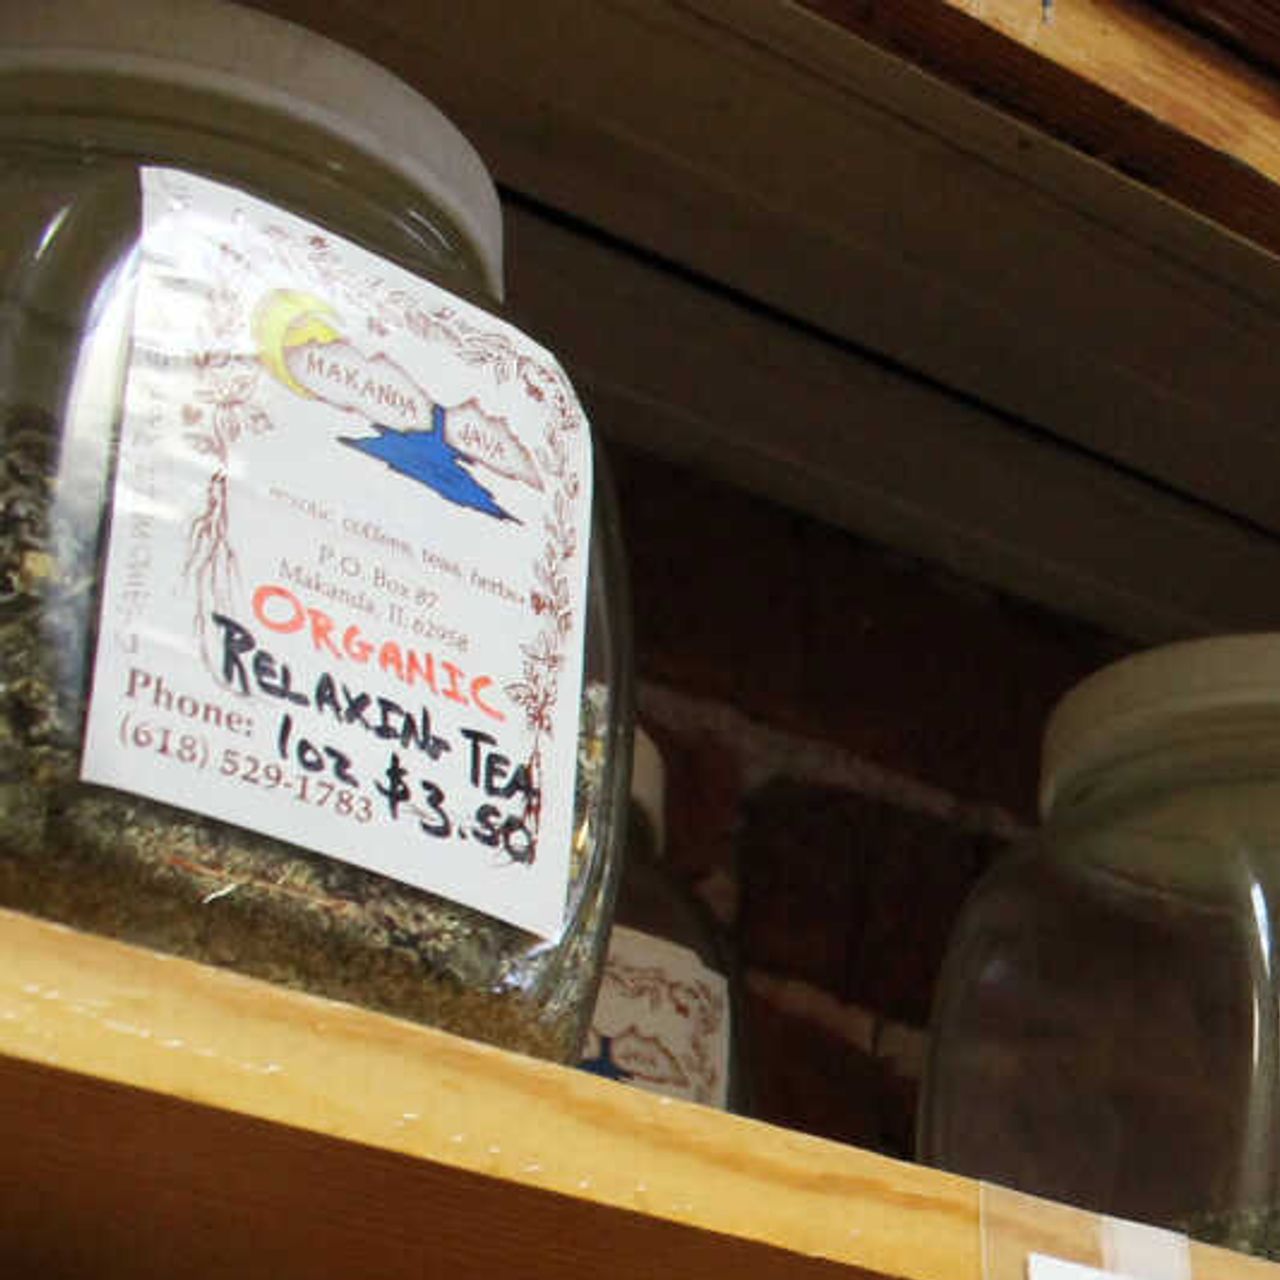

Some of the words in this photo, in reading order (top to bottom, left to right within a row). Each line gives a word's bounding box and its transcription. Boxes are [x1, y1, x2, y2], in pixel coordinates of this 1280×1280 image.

[306, 352, 418, 418] MAKANDA
[457, 424, 506, 455] JAVA
[373, 567, 409, 598] Box
[252, 585, 507, 723] ORGANIC
[126, 667, 256, 739] Phone:
[119, 712, 208, 770] (618)
[220, 748, 375, 824] 529-1783
[459, 727, 541, 801] TEA
[374, 751, 536, 866] $3.50
